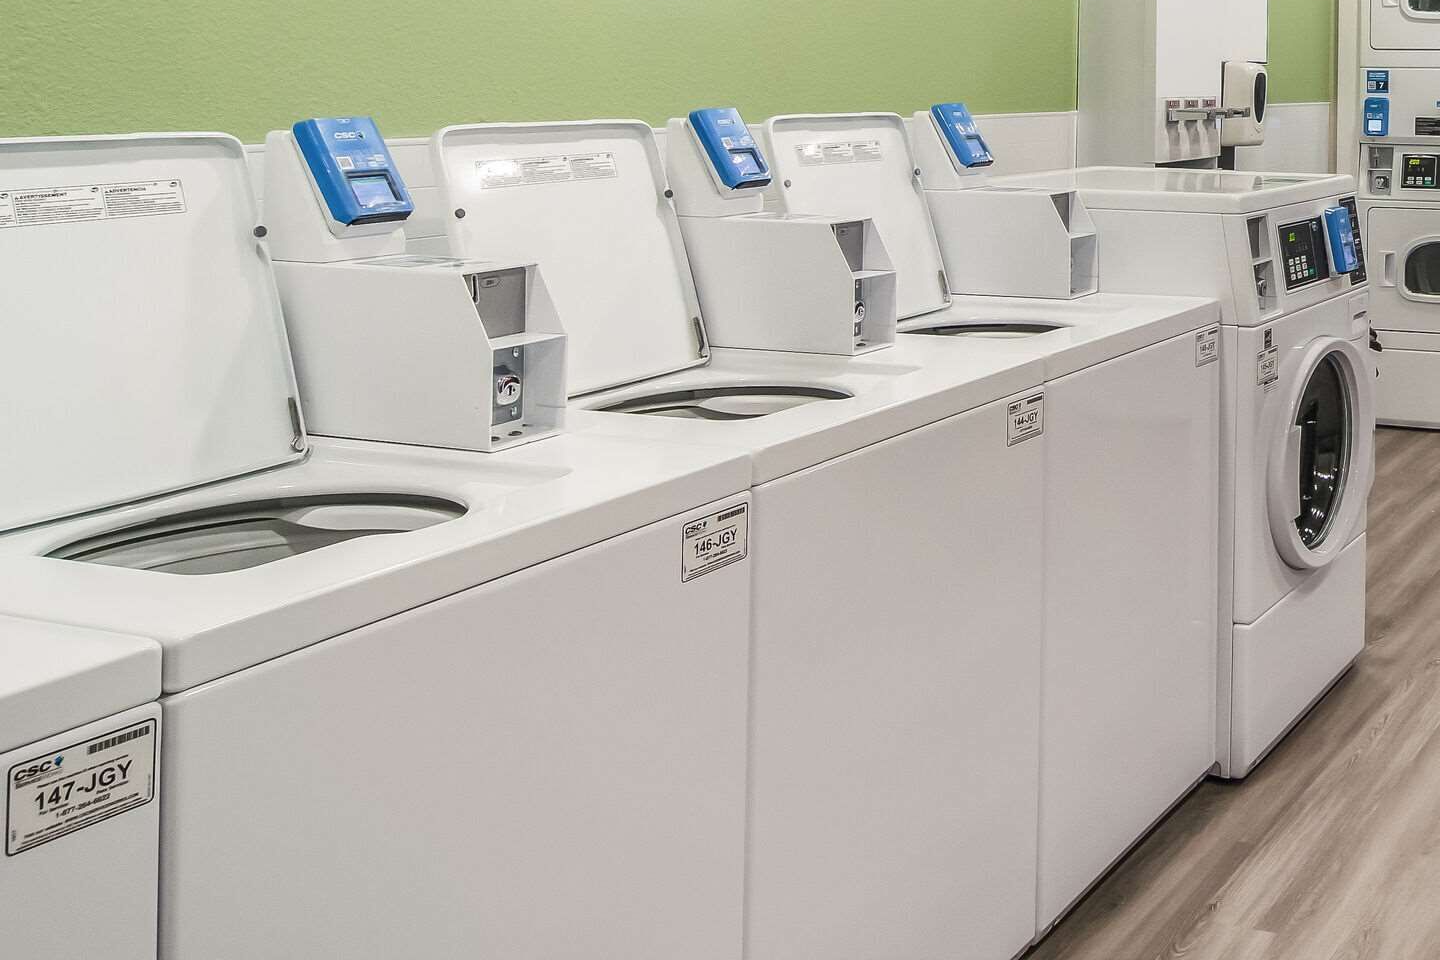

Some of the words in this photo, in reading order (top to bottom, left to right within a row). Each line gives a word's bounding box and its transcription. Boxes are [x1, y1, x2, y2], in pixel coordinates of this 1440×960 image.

[694, 528, 738, 556] 146-JGY
[13, 760, 52, 782] CSC
[34, 759, 133, 811] 147-JGY
